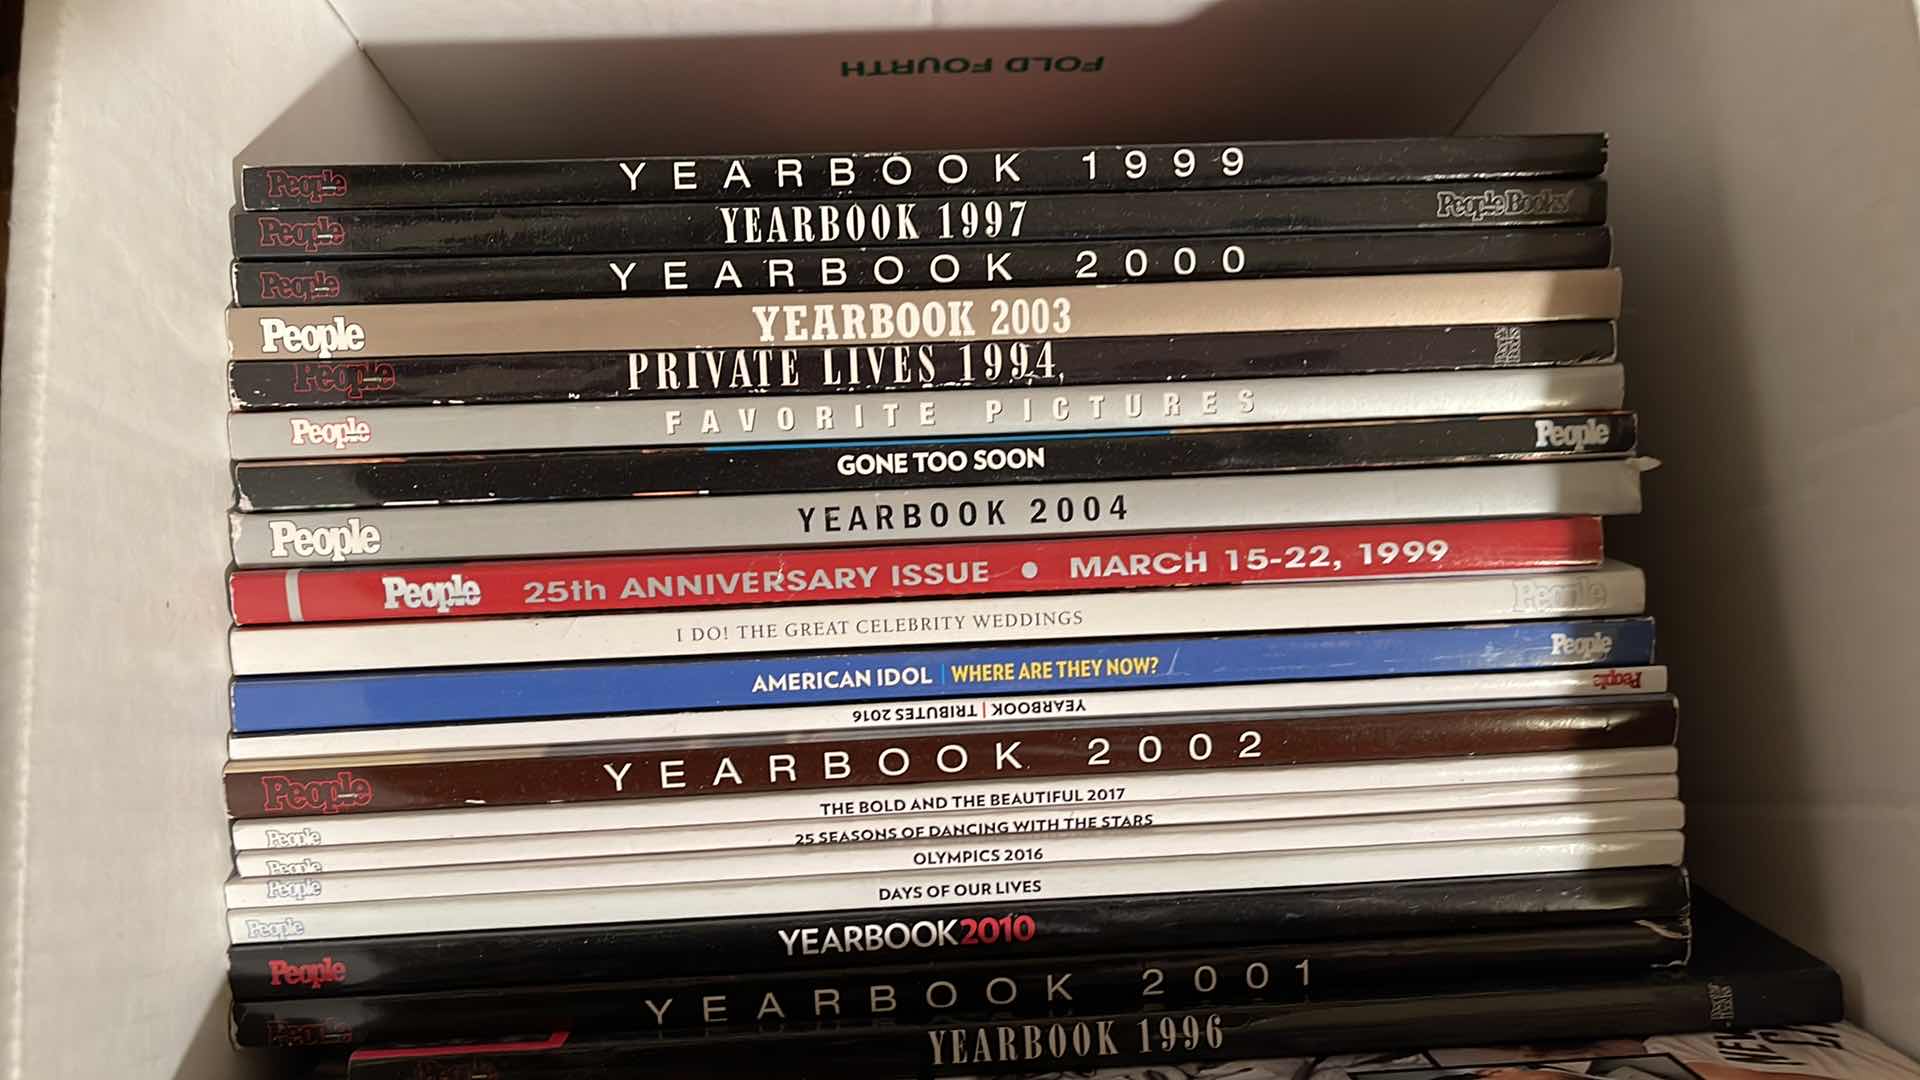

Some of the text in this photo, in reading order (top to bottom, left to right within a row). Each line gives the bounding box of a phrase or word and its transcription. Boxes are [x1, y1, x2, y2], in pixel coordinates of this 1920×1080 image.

[840, 55, 1104, 77] FOLD FOURTH
[266, 169, 347, 202] People
[619, 147, 1245, 192] YEARBOOK 1999
[258, 216, 344, 252] People
[720, 199, 1028, 244] YEARBOOK 1997
[260, 271, 340, 300] People
[609, 246, 1246, 292] YEARBOOK 2000
[753, 297, 1072, 342] YEARBOOK 2003
[260, 316, 365, 359] People
[293, 361, 396, 400] People
[628, 340, 1057, 391] PRIVATE LIVES 1994
[665, 389, 1256, 435] FAVORITE PICTURES
[290, 417, 372, 449] People
[1535, 418, 1610, 453] People
[837, 447, 1045, 476] GONE TOO SOON
[797, 494, 1129, 533] YEARBOOK 2004
[270, 518, 381, 561] People
[382, 539, 1449, 609] People 25th ANNIVERSARY ISSUE MARCH 15-22, 1999
[676, 609, 1084, 643] I DO! THE GREAT CELEBRITY WEDDINGS
[1551, 632, 1613, 659] People
[751, 656, 1159, 694] AMERICAN IDOL WHERE ARE THEY NOW?
[1592, 669, 1643, 689] People
[852, 698, 1087, 723] YEARBOOK TRIBUTES 2016
[605, 730, 1263, 793] YEARBOOK 2002
[262, 772, 373, 814] People
[820, 786, 1126, 817] THE BOLD AND THE BEAUTIFUL 2017
[265, 828, 322, 849] People
[794, 813, 1154, 846] 25 SEASONS OF DANCING WITH THE STARS
[266, 859, 323, 877] People
[913, 847, 1044, 867] OLYMPICS 2016
[266, 879, 322, 901] People
[878, 879, 1042, 902] DAYS OF OUR LIVES
[246, 917, 305, 941] People
[268, 957, 347, 989] People
[645, 959, 1311, 1027] YEARBOOK 2001
[929, 1012, 1225, 1066] YEARBOOK 1996
